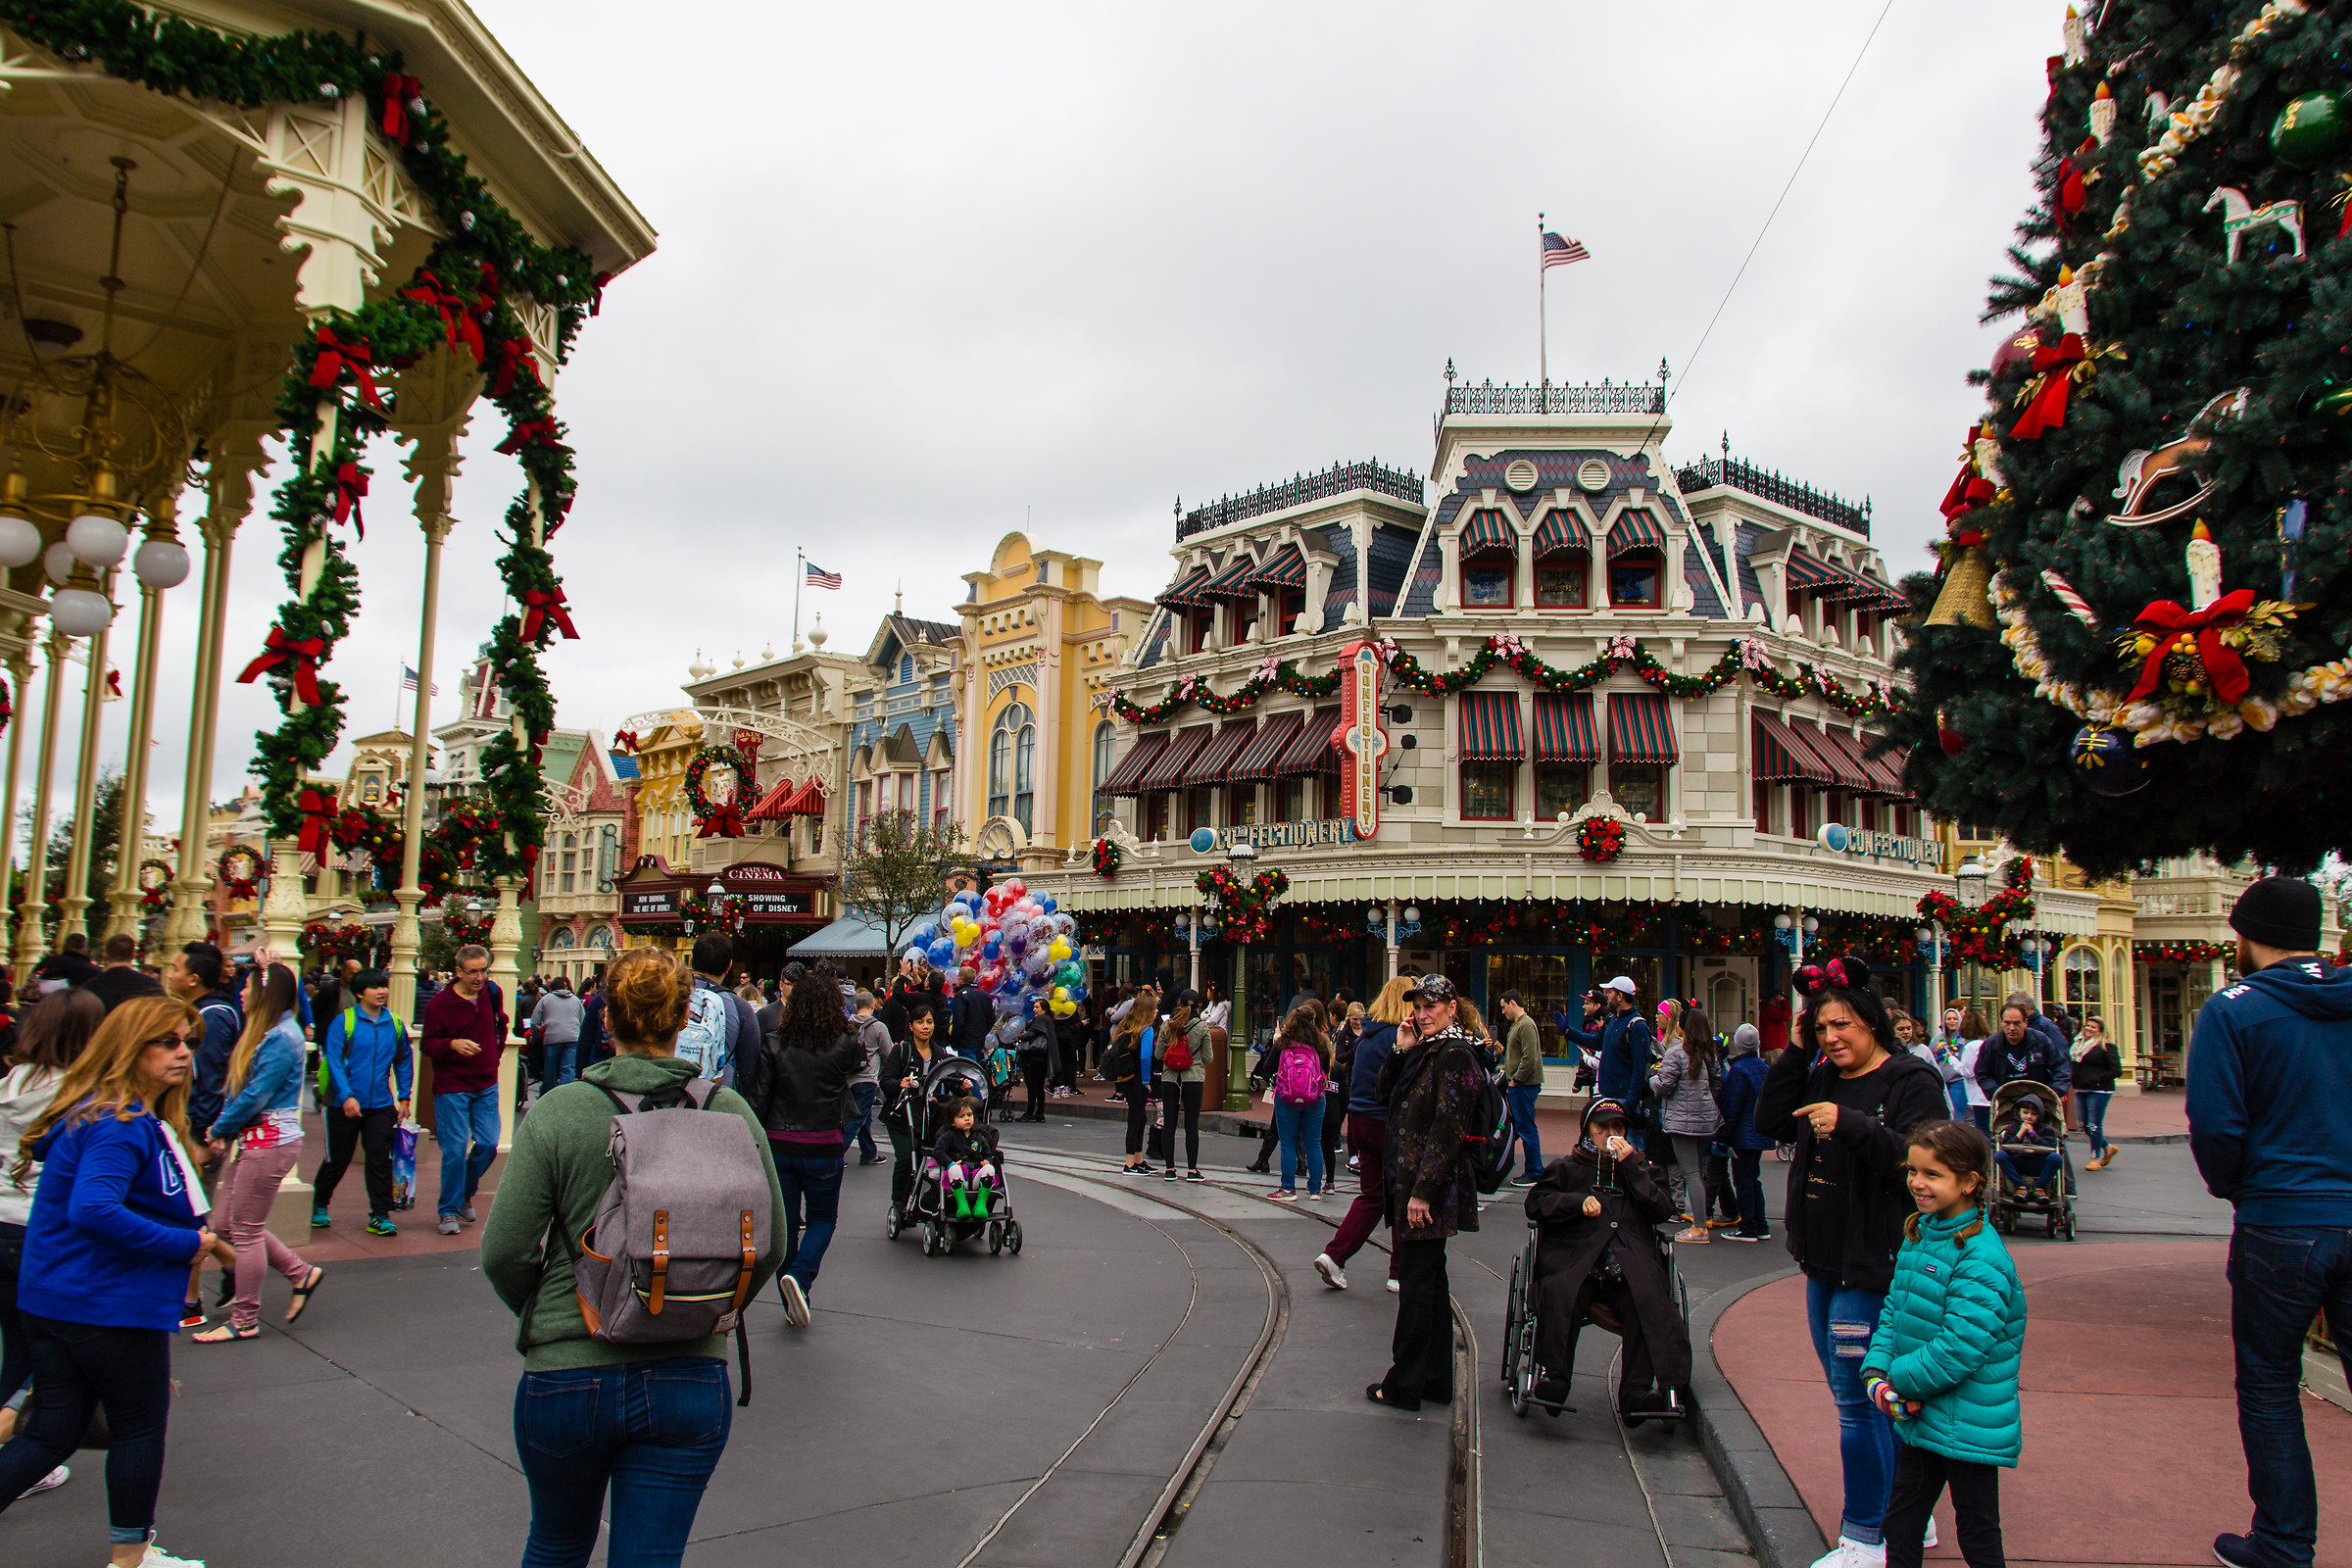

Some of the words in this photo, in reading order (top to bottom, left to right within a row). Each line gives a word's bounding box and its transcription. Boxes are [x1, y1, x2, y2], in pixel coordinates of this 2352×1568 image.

[1361, 663, 1371, 825] CONFECTIONERY
[1848, 826, 1945, 865] CONFECTIONERY
[728, 869, 783, 880] CINEMA
[648, 894, 666, 903] SHOWING
[748, 894, 786, 903] SHOWING
[657, 904, 671, 912] DISNEY
[753, 904, 764, 912] OF
[2221, 984, 2252, 1000] HH
[1815, 1133, 1833, 1145] pon
